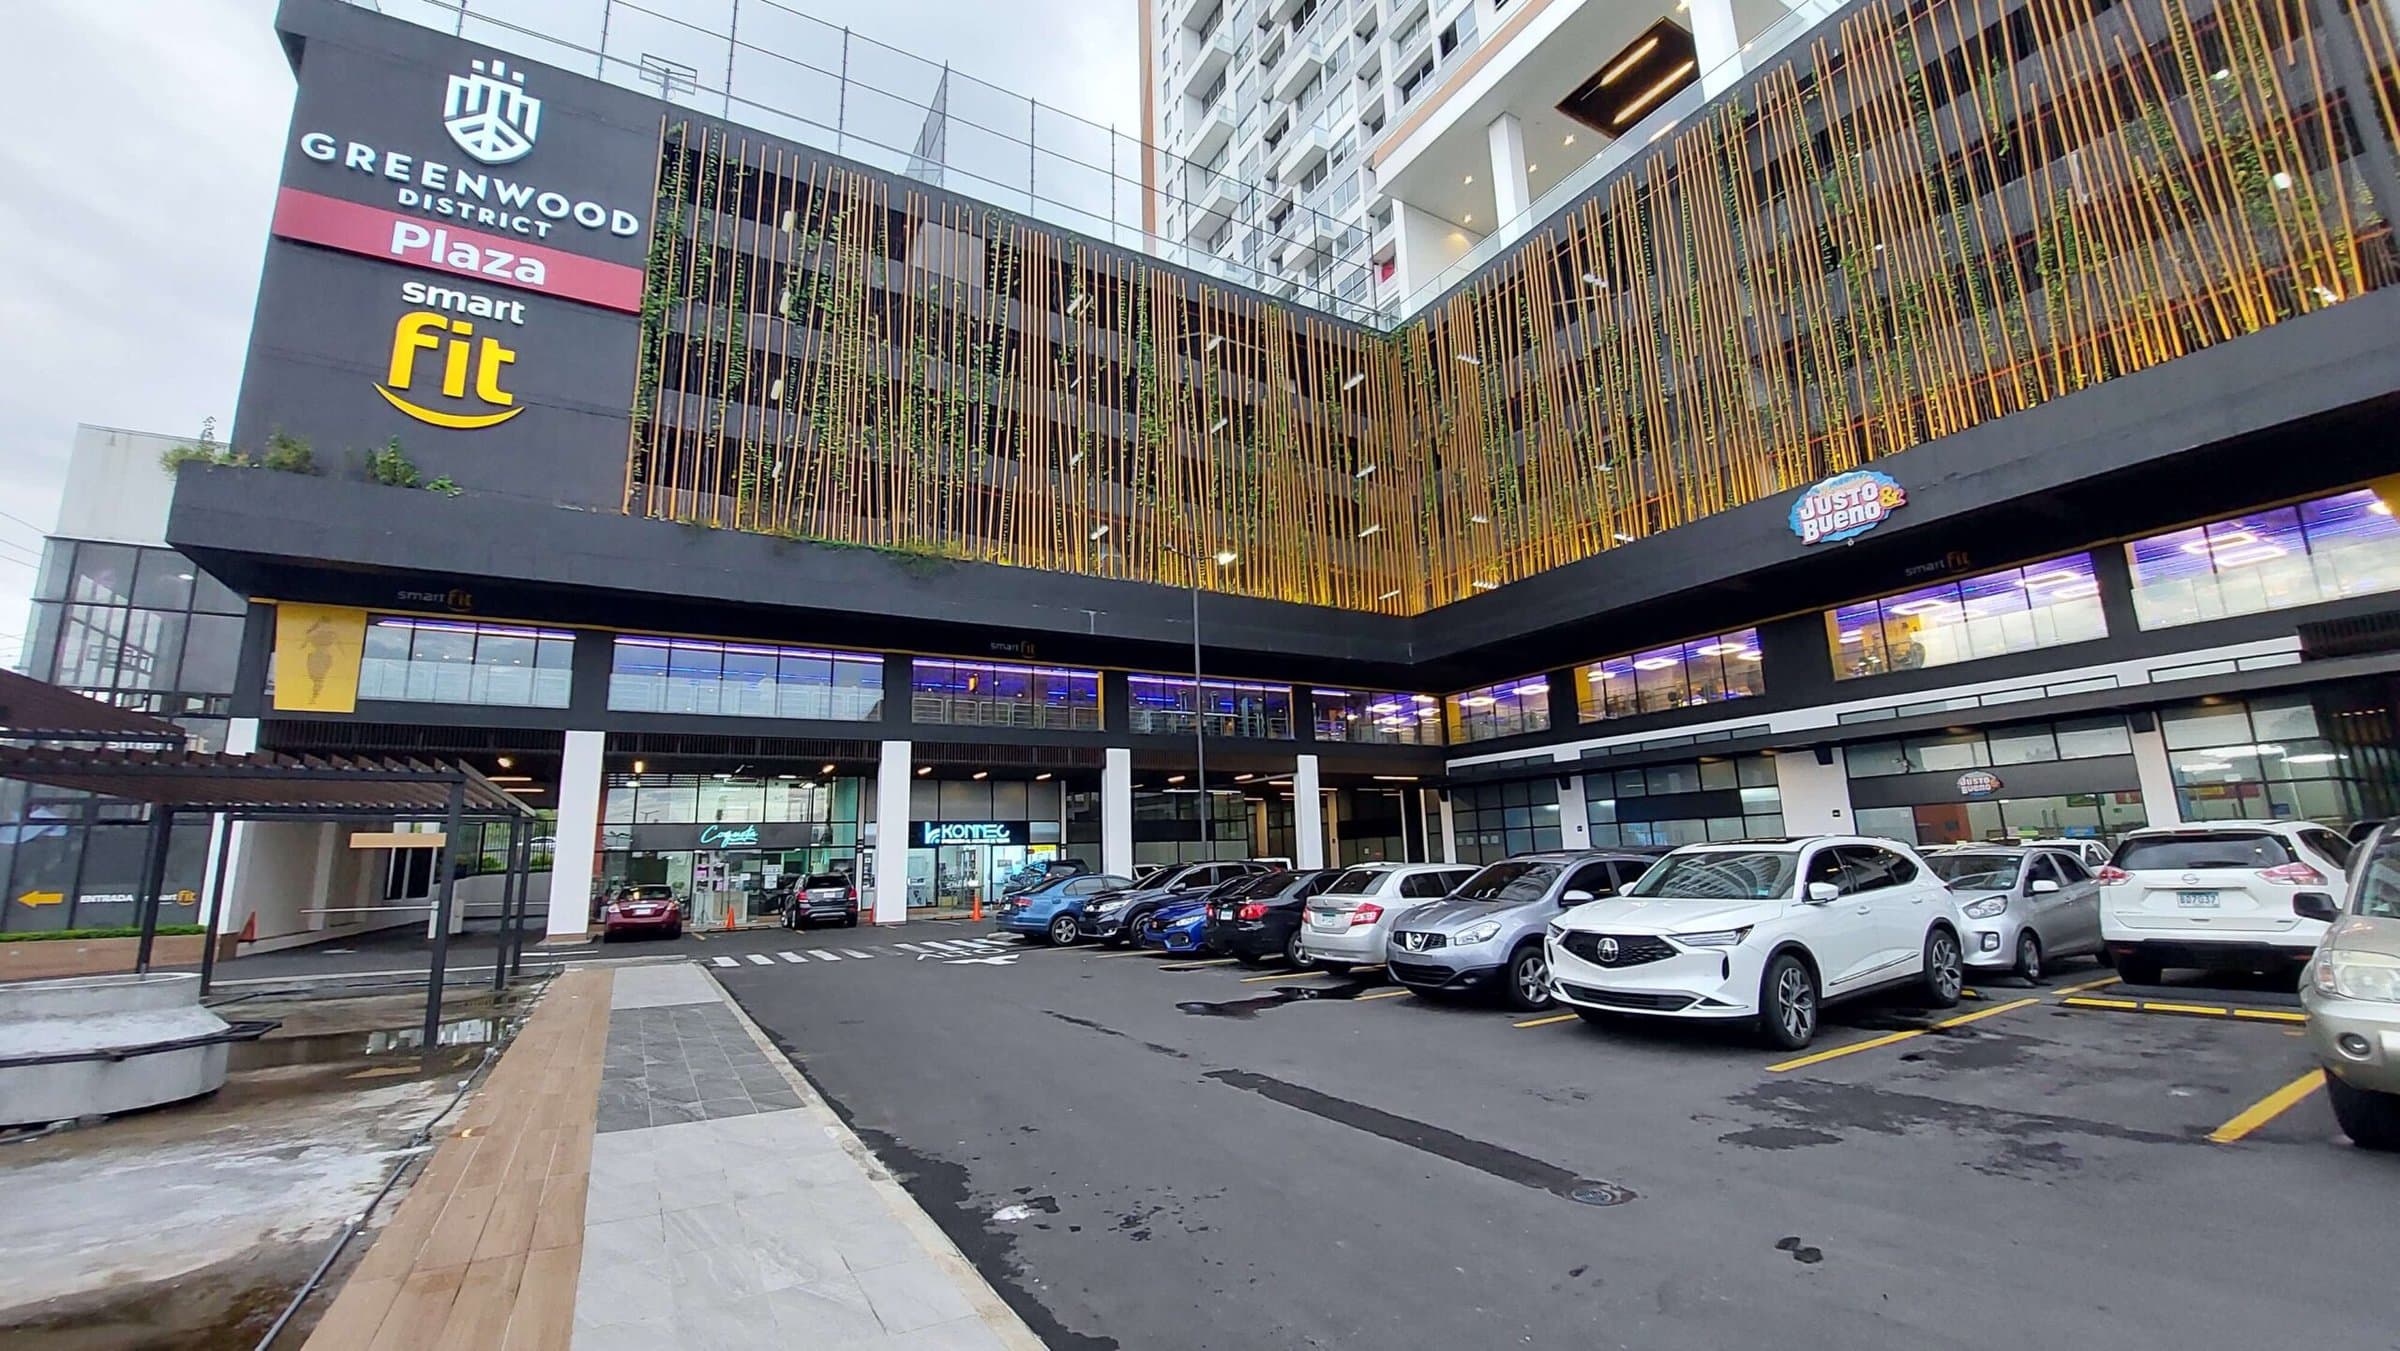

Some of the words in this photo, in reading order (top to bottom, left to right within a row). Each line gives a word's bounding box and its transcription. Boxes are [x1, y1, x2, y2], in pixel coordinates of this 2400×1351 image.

[300, 131, 640, 238] GREENWOOD
[398, 187, 552, 239] DISTRICT
[390, 219, 547, 288] Plaza
[401, 279, 526, 326] smart
[387, 311, 516, 406] fit
[1800, 482, 1879, 520] JUSTO
[1904, 559, 1946, 577] smart
[1946, 551, 1969, 569] fit
[397, 590, 446, 602] smart
[446, 588, 473, 606] fit
[990, 641, 1019, 652] smart
[1020, 640, 1036, 655] fit
[79, 893, 134, 903] ENTRADA
